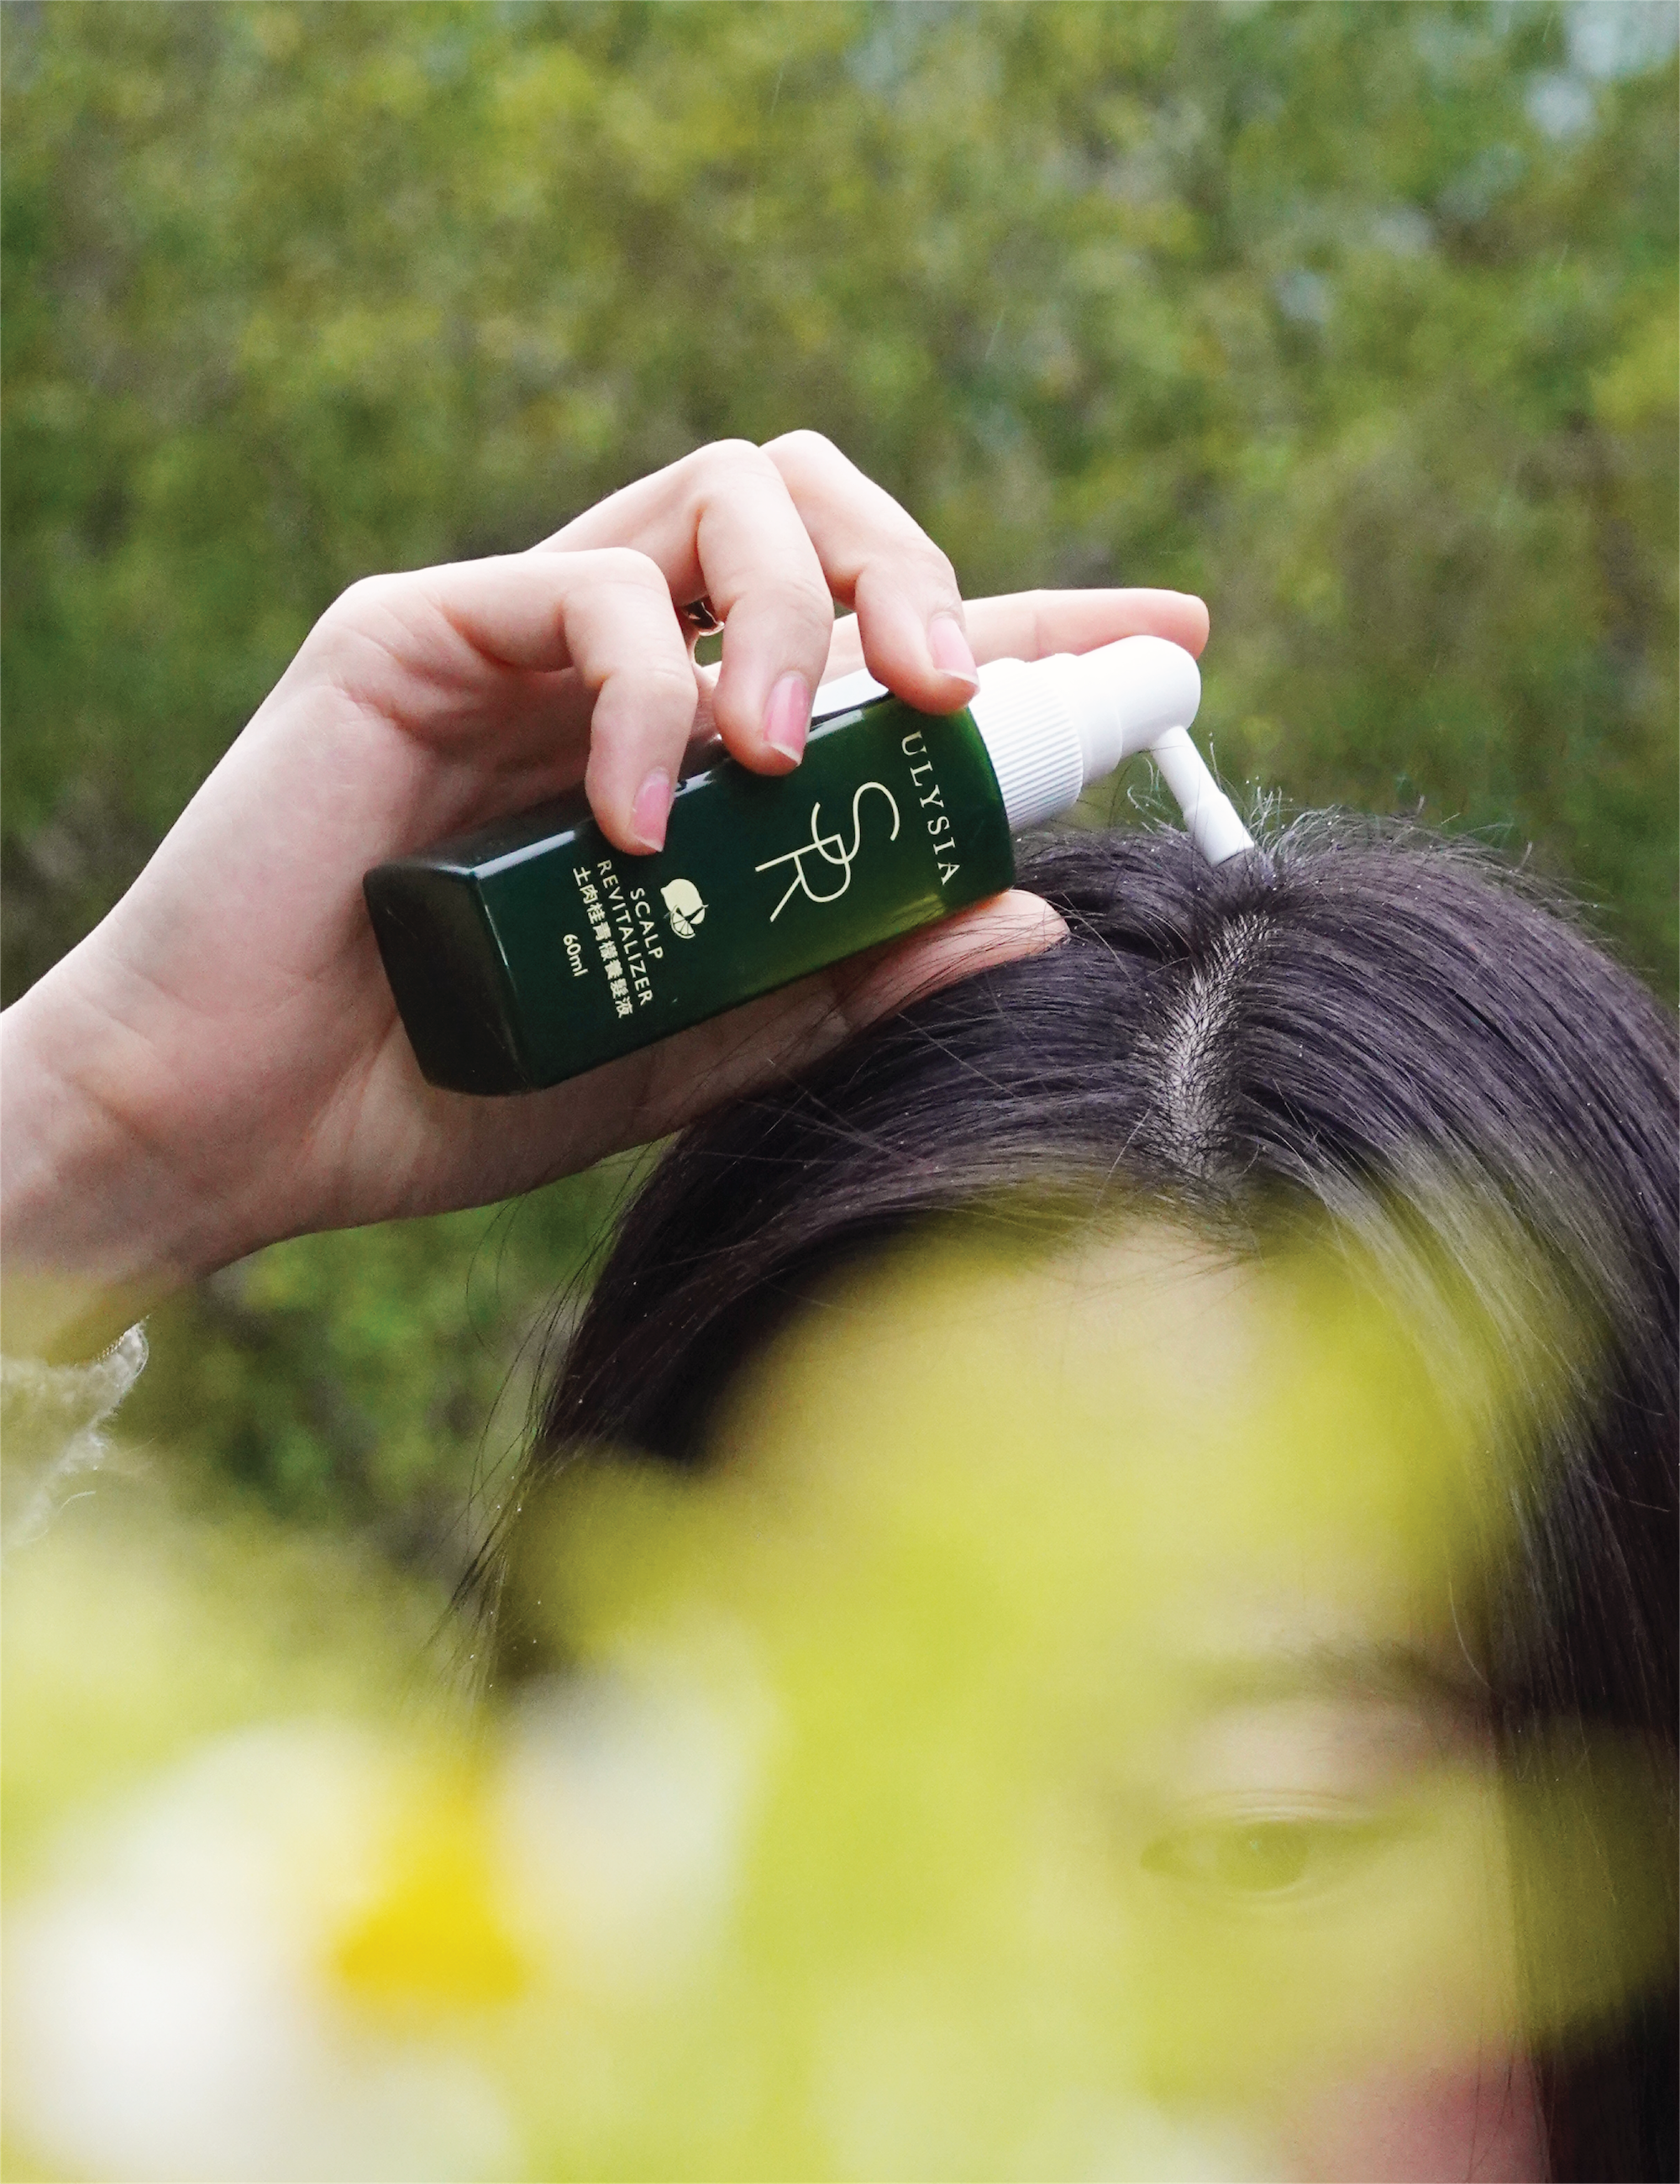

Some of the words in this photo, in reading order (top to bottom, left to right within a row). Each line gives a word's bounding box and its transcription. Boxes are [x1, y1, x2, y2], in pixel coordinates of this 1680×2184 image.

[901, 731, 961, 885] ULYSIA
[563, 933, 589, 978] 60ml
[573, 866, 633, 1019] 土肉桂青檬養髮液
[597, 859, 654, 1006] REVITALIZER
[630, 887, 664, 959] SCALP
